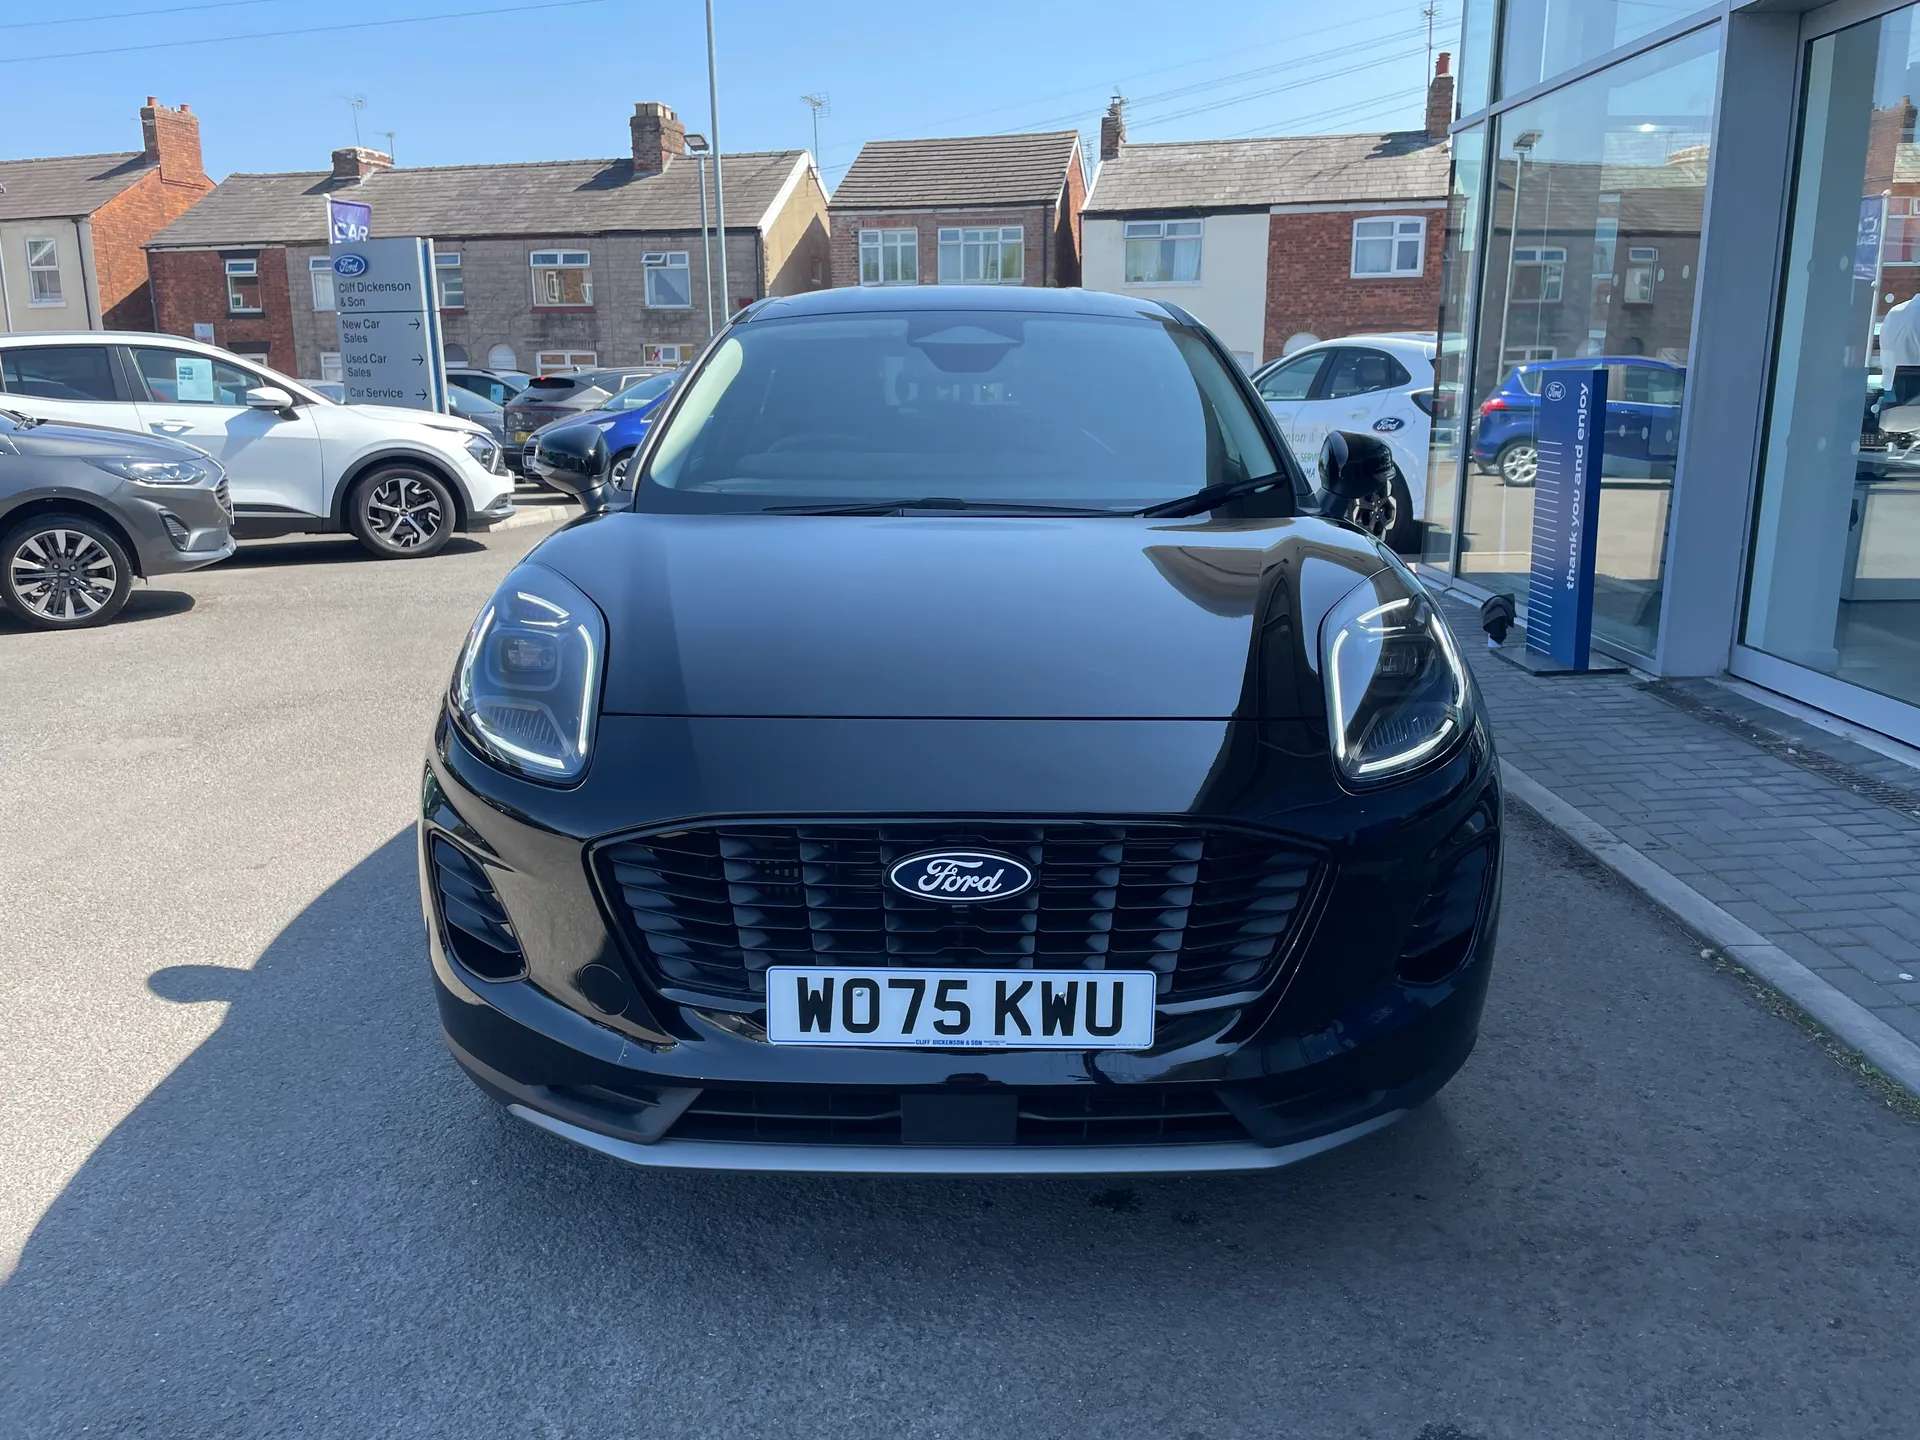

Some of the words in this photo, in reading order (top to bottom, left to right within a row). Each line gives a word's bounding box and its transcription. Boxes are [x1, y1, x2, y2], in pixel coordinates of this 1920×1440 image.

[334, 222, 369, 242] CAR
[339, 282, 355, 293] Cliff
[357, 281, 411, 293] Dickenson
[340, 297, 346, 307] &
[348, 297, 366, 307] Son
[342, 319, 361, 330] New
[363, 319, 380, 329] Car
[344, 333, 368, 343] Sales
[346, 353, 368, 364] Used
[369, 353, 386, 364] Car
[348, 367, 371, 377] Sales
[350, 387, 364, 398] Car
[366, 387, 404, 398] Service
[1577, 382, 1589, 441] enjoy
[1574, 444, 1584, 486] and
[1570, 490, 1581, 527] you
[1567, 531, 1578, 590] thank
[918, 859, 1005, 892] Ford
[796, 977, 971, 1035] WO75
[994, 980, 1124, 1036] KWU
